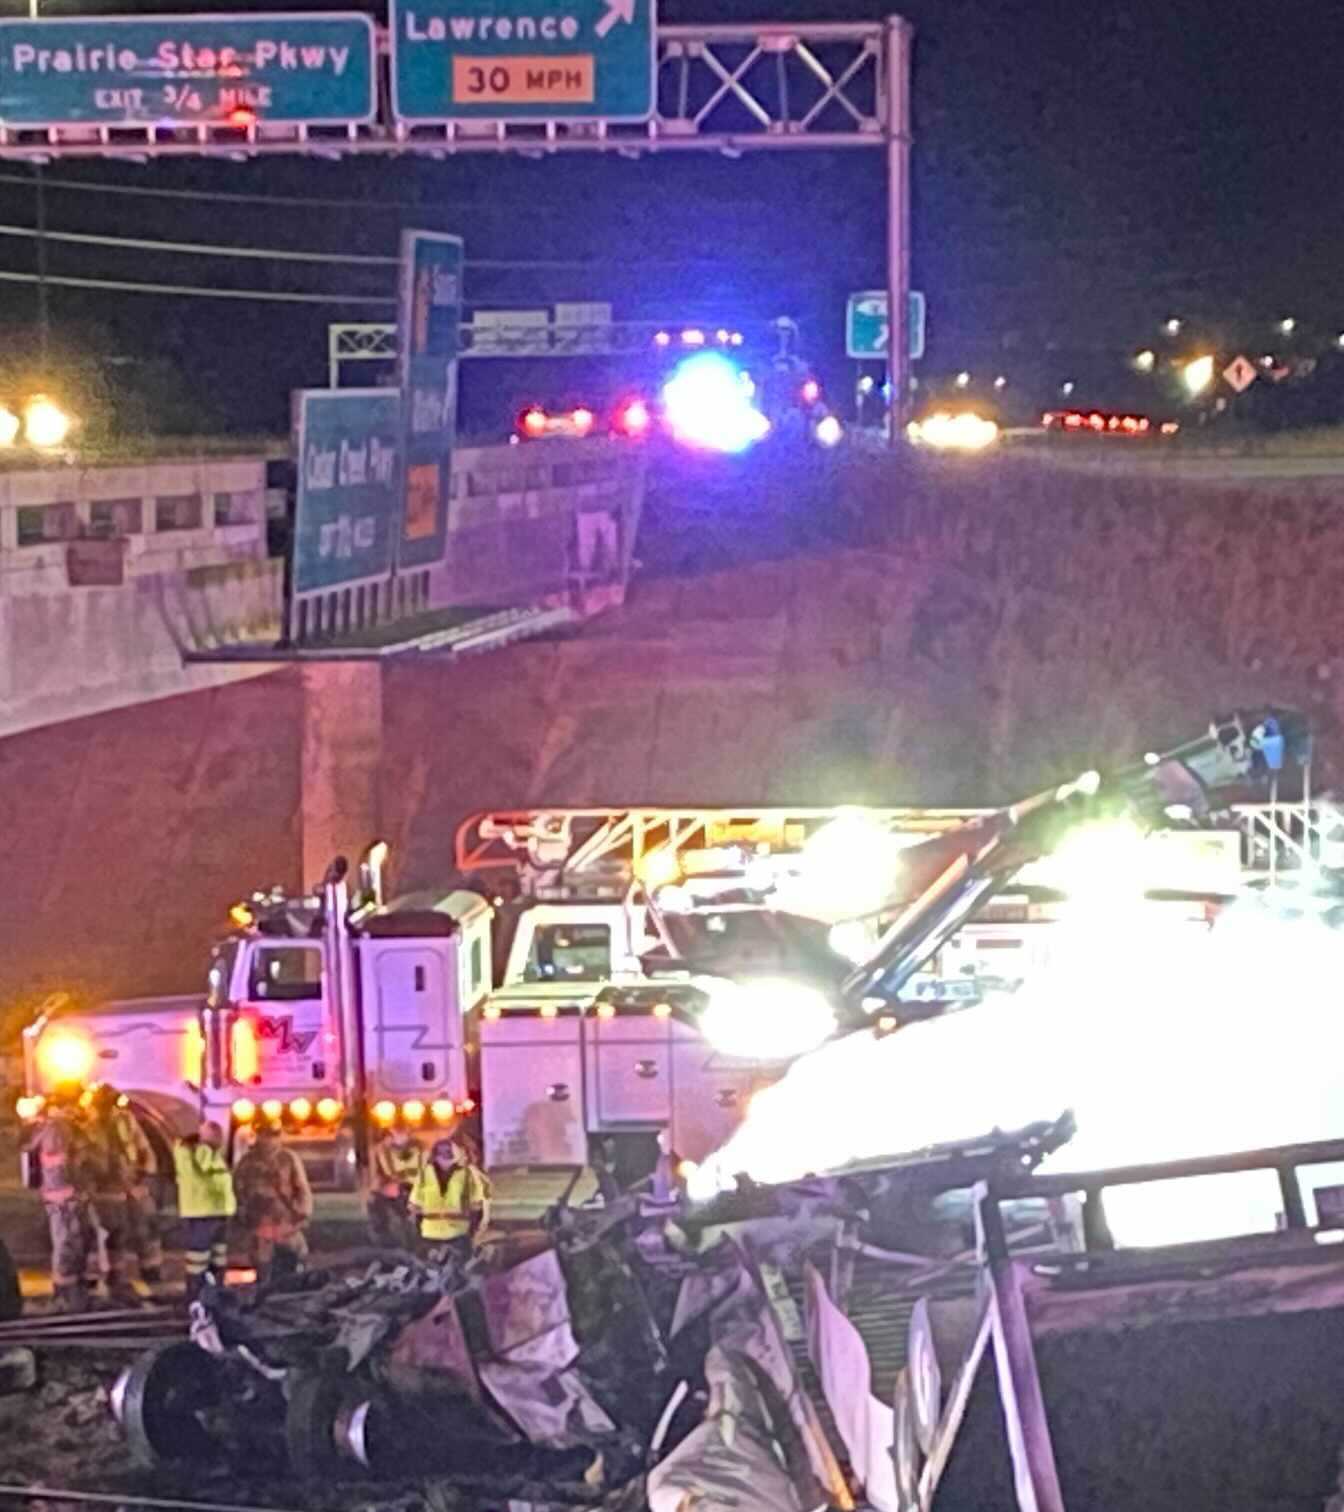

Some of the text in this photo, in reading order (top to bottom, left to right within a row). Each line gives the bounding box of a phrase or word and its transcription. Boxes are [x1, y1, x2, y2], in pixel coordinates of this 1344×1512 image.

[406, 11, 578, 40] Lawrence
[13, 39, 349, 75] Prairie Star Pkwy
[467, 66, 583, 93] 30 MPH
[93, 85, 272, 111] EXIT 3/4 MILE
